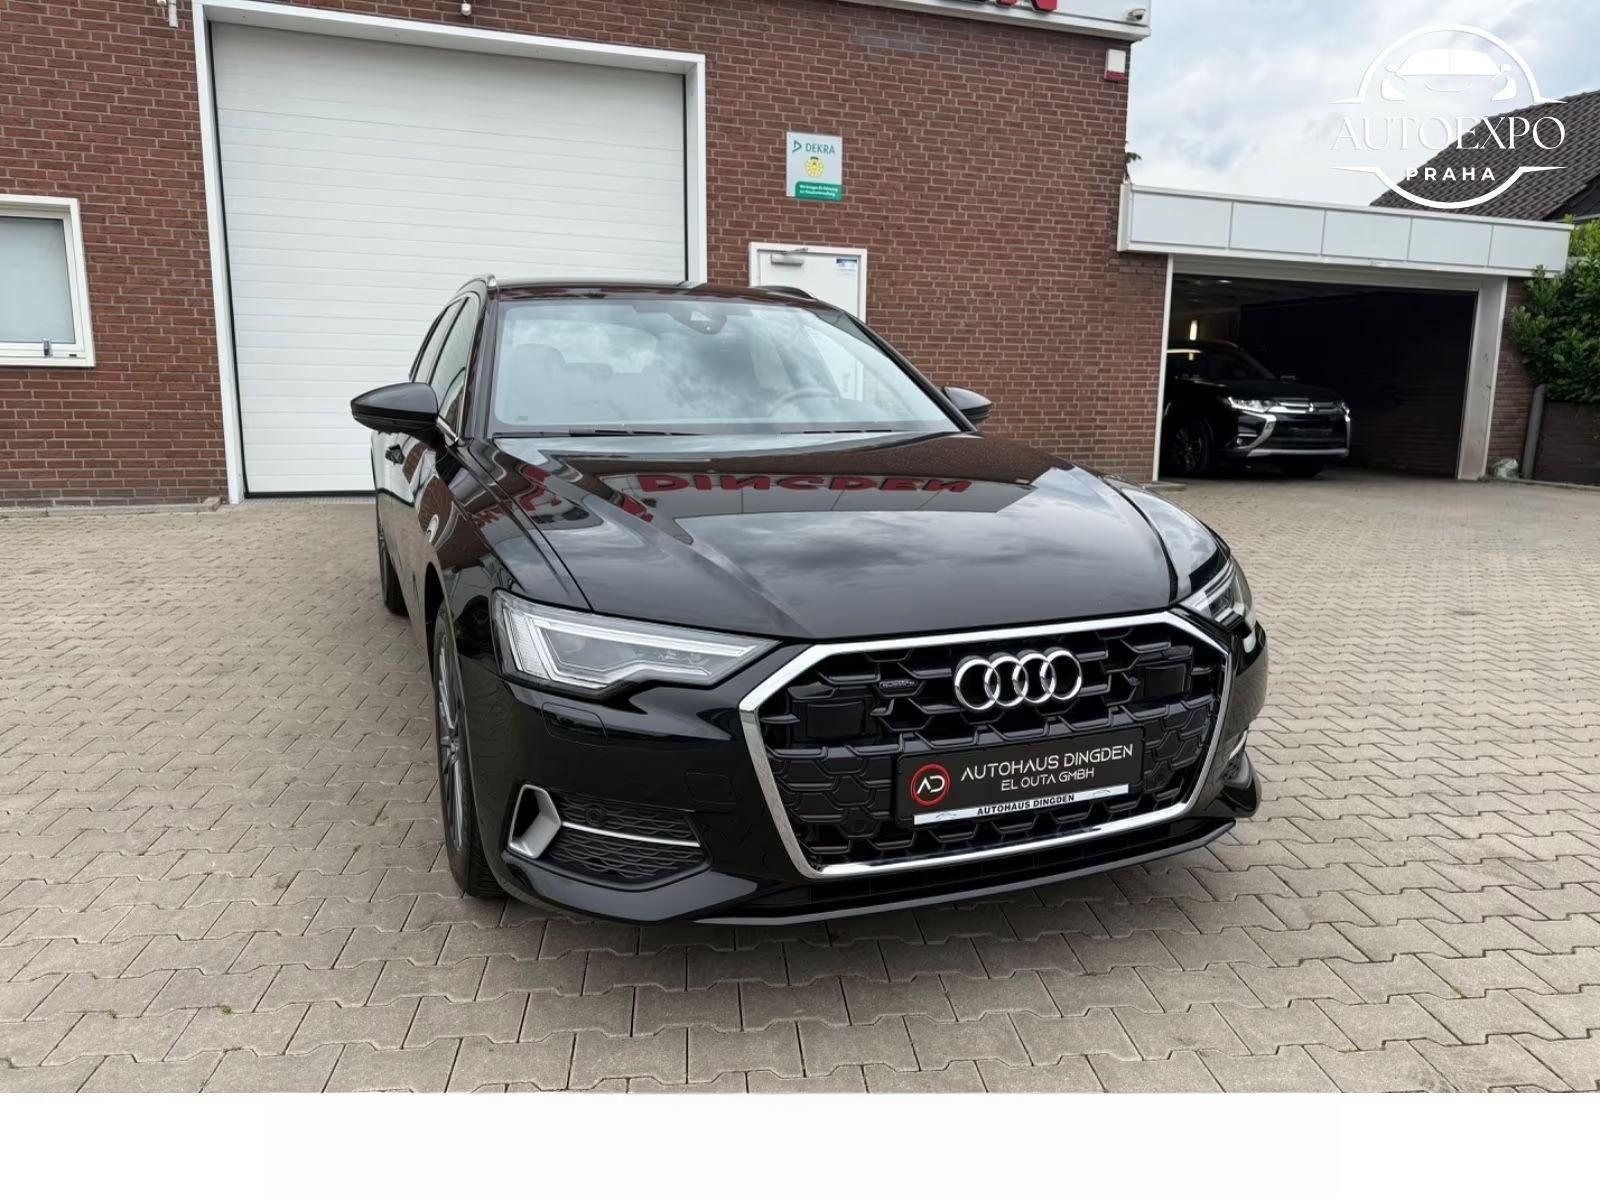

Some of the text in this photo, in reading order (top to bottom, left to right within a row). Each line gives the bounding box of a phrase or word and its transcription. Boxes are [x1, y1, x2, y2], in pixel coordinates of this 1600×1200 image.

[805, 142, 835, 154] DEKRA
[961, 744, 1133, 782] AUTOHAUS DINGDEN
[1001, 767, 1095, 791] EL OUTA GMBH
[977, 794, 1075, 816] AUTOHAUS DINGDEN
